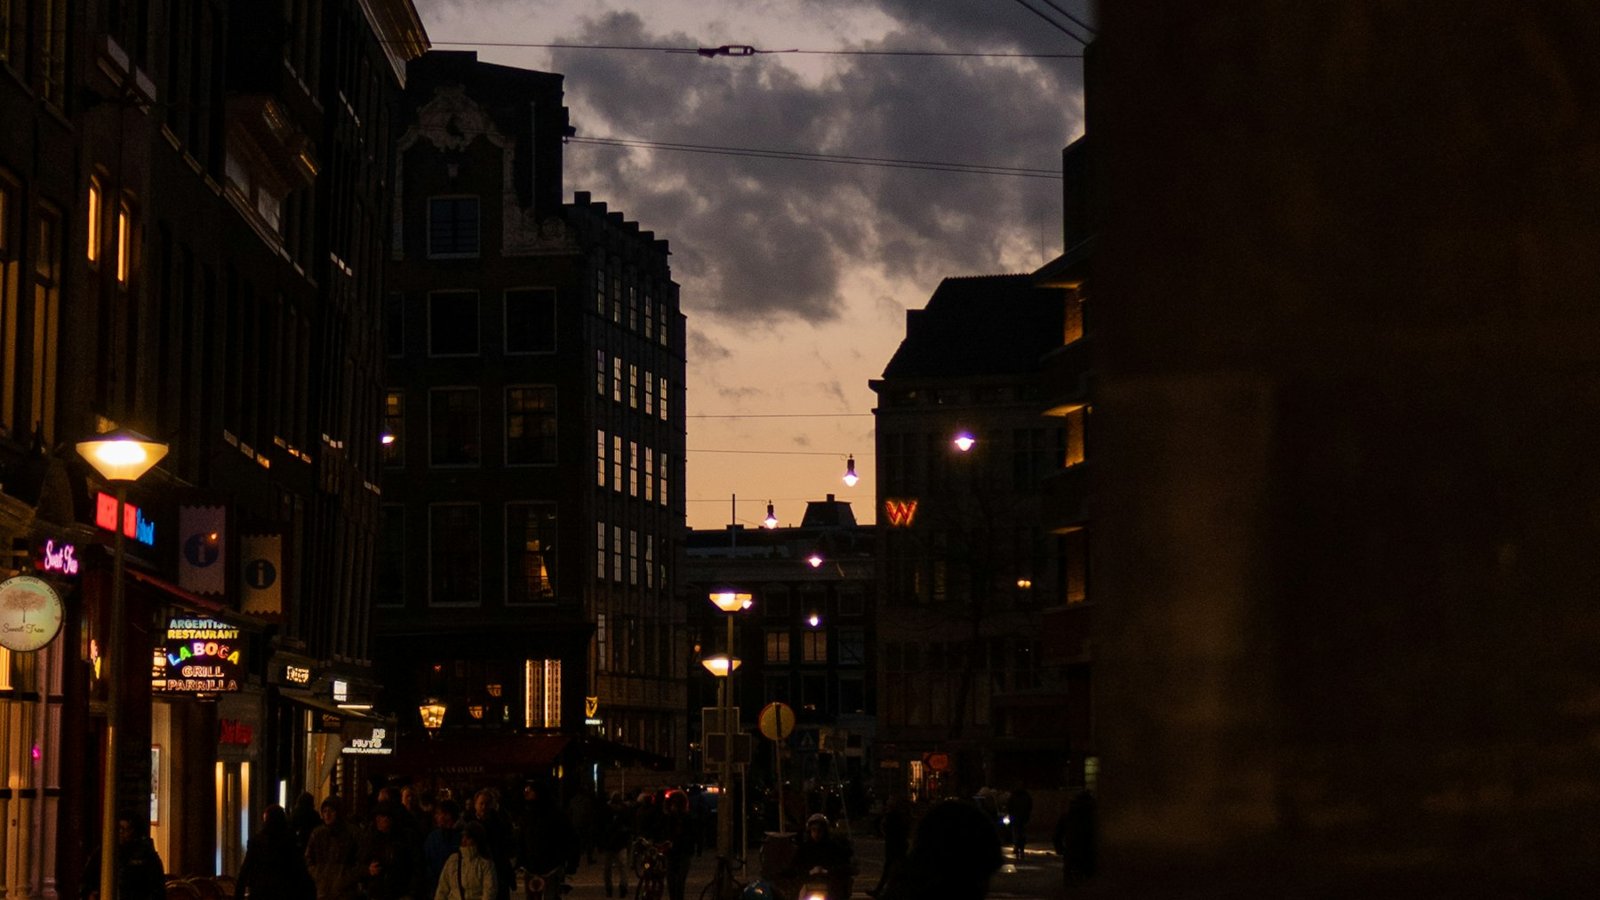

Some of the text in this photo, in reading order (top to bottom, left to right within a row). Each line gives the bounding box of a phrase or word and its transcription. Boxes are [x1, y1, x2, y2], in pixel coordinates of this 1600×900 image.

[883, 499, 918, 527] W
[167, 629, 239, 639] RESTAURANT
[167, 642, 240, 666] LA BOCA
[182, 666, 225, 678] GRILL
[167, 679, 238, 691] PARRILLA
